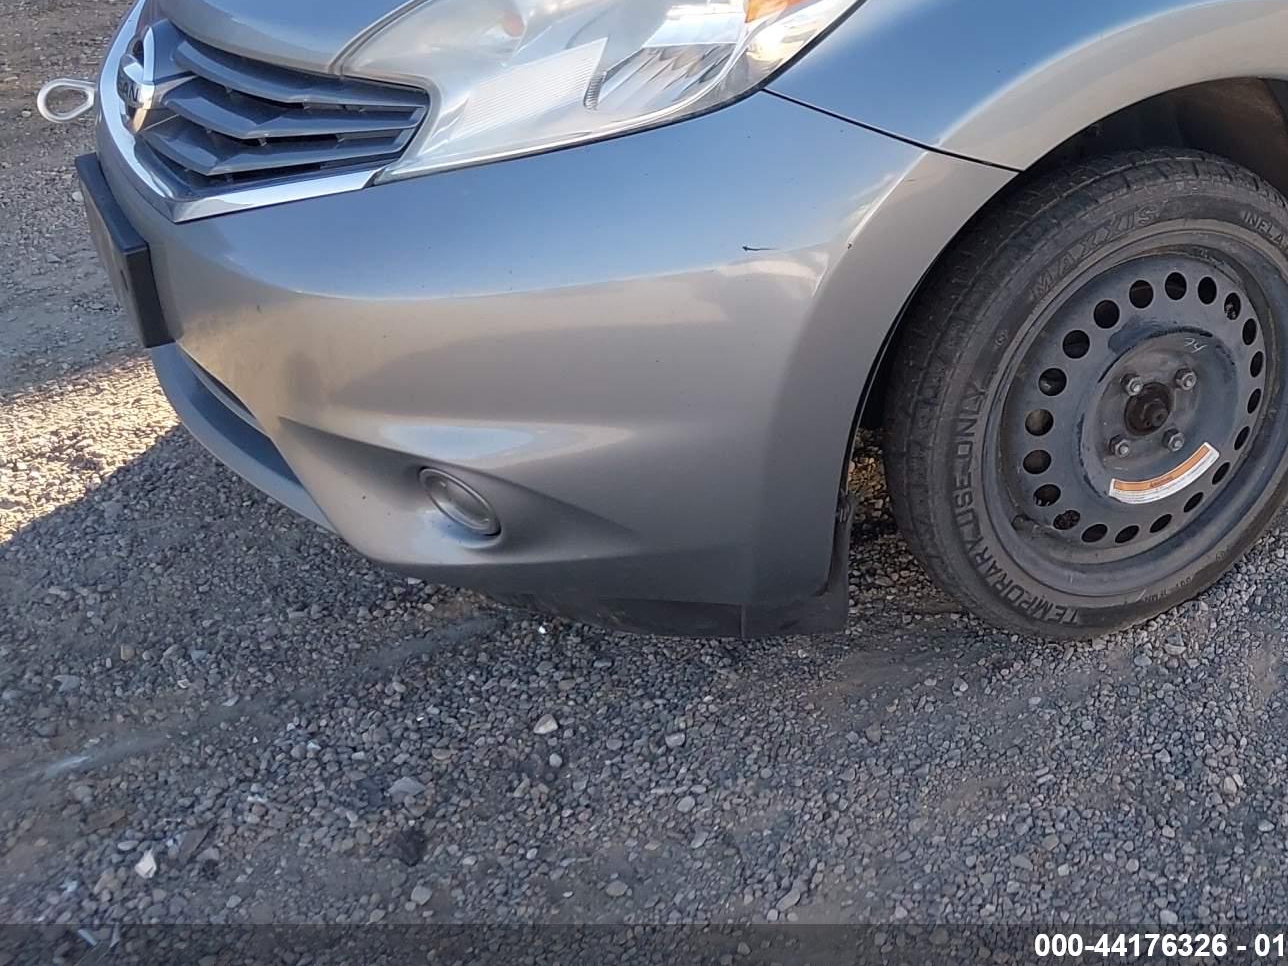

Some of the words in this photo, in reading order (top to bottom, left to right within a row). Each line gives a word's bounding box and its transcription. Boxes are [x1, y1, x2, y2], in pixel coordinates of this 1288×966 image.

[1029, 204, 1160, 300] MAXXIS
[957, 381, 987, 458] ONLY
[953, 472, 981, 527] USE
[964, 536, 1080, 625] TEMPORARY
